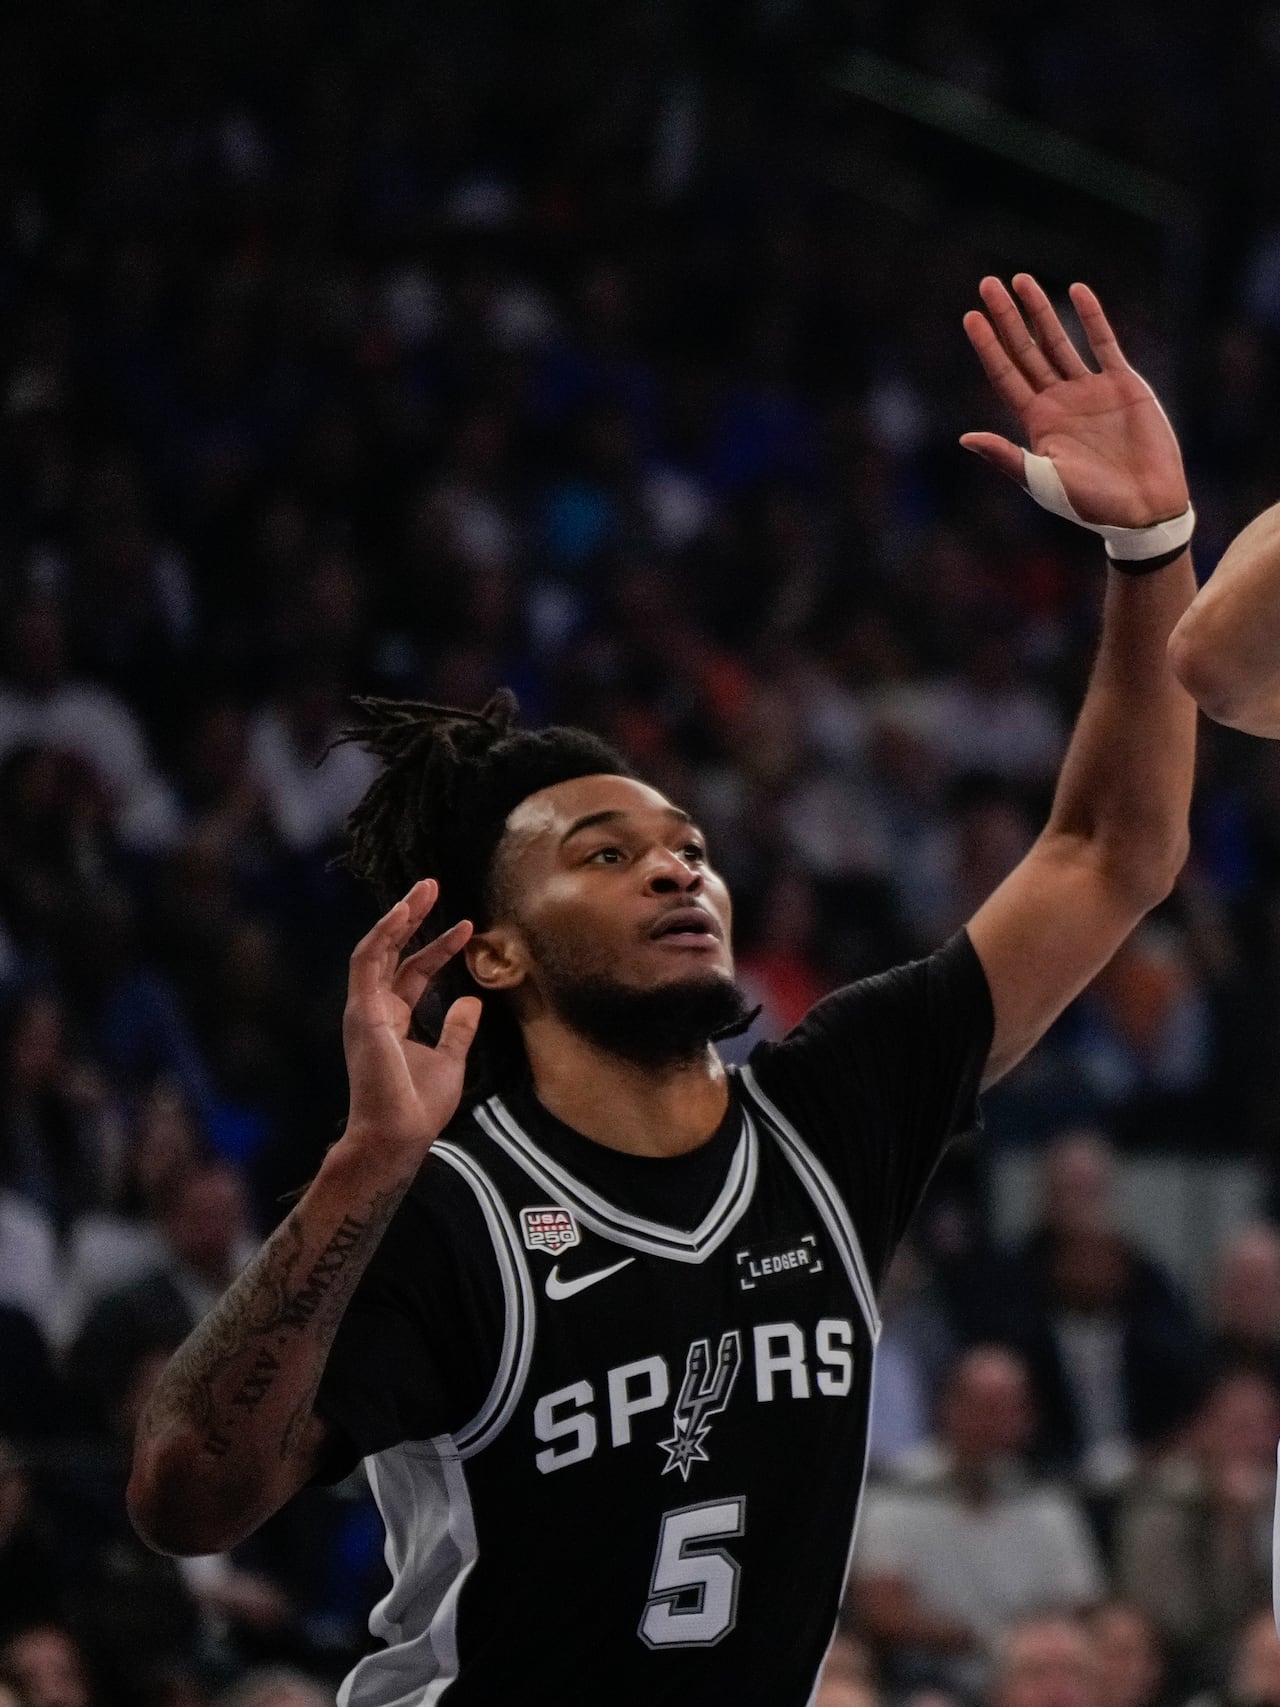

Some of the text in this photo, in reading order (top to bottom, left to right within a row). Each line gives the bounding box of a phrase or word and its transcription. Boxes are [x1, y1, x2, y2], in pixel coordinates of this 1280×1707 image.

[527, 1213, 569, 1225] USA
[530, 1230, 577, 1245] 250
[749, 1249, 809, 1277] LEDGER
[533, 1319, 853, 1482] SPURS
[637, 1495, 746, 1650] 5
